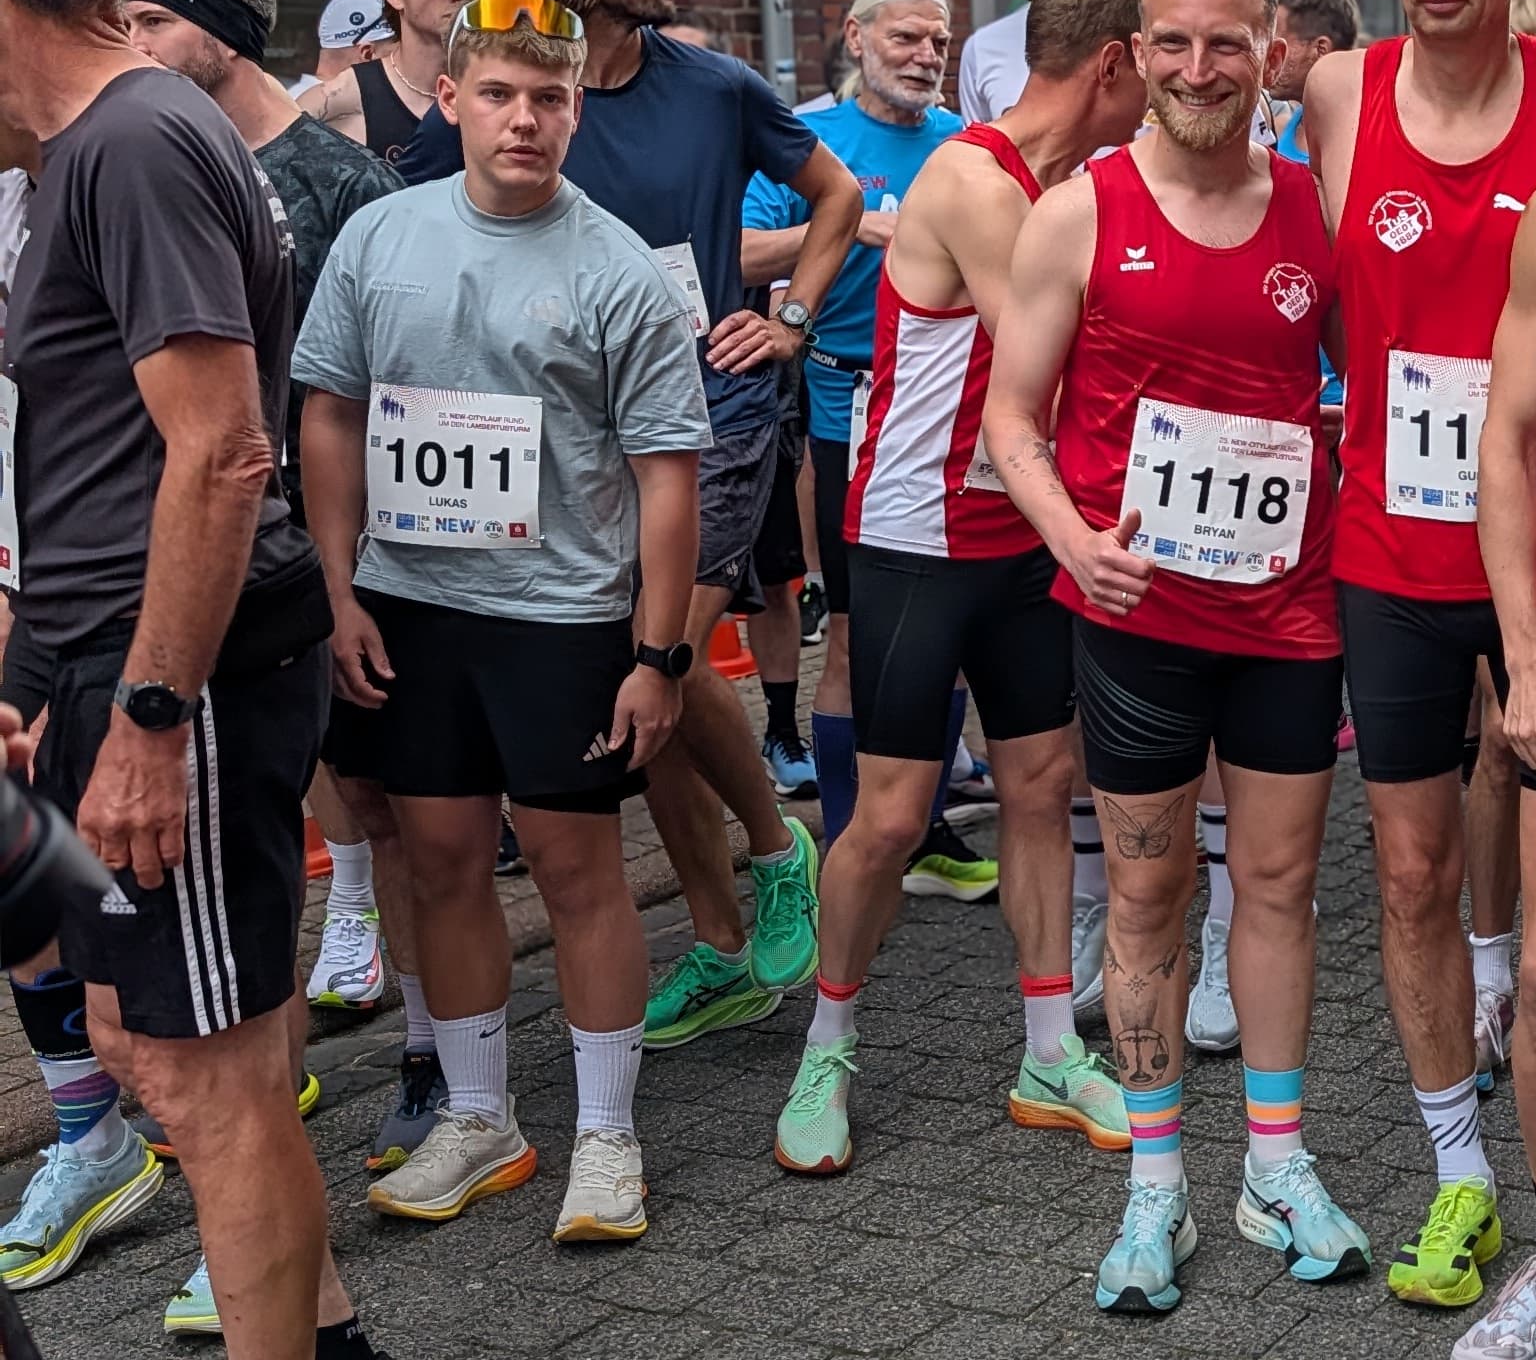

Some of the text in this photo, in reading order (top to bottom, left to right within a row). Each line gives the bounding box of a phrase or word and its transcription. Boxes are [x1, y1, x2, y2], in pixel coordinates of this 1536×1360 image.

[1384, 209, 1409, 229] TuS
[1390, 219, 1413, 239] OEDT
[1395, 228, 1418, 247] 1884
[1279, 281, 1300, 300] TuS
[1286, 291, 1305, 310] OEDT
[1291, 300, 1308, 318] 1884
[1410, 409, 1467, 460] 11
[386, 438, 510, 493] 1011
[1458, 470, 1478, 481] GU
[1153, 460, 1290, 525] 1118
[429, 496, 468, 509] LUKAS
[1194, 524, 1236, 540] BRYAN
